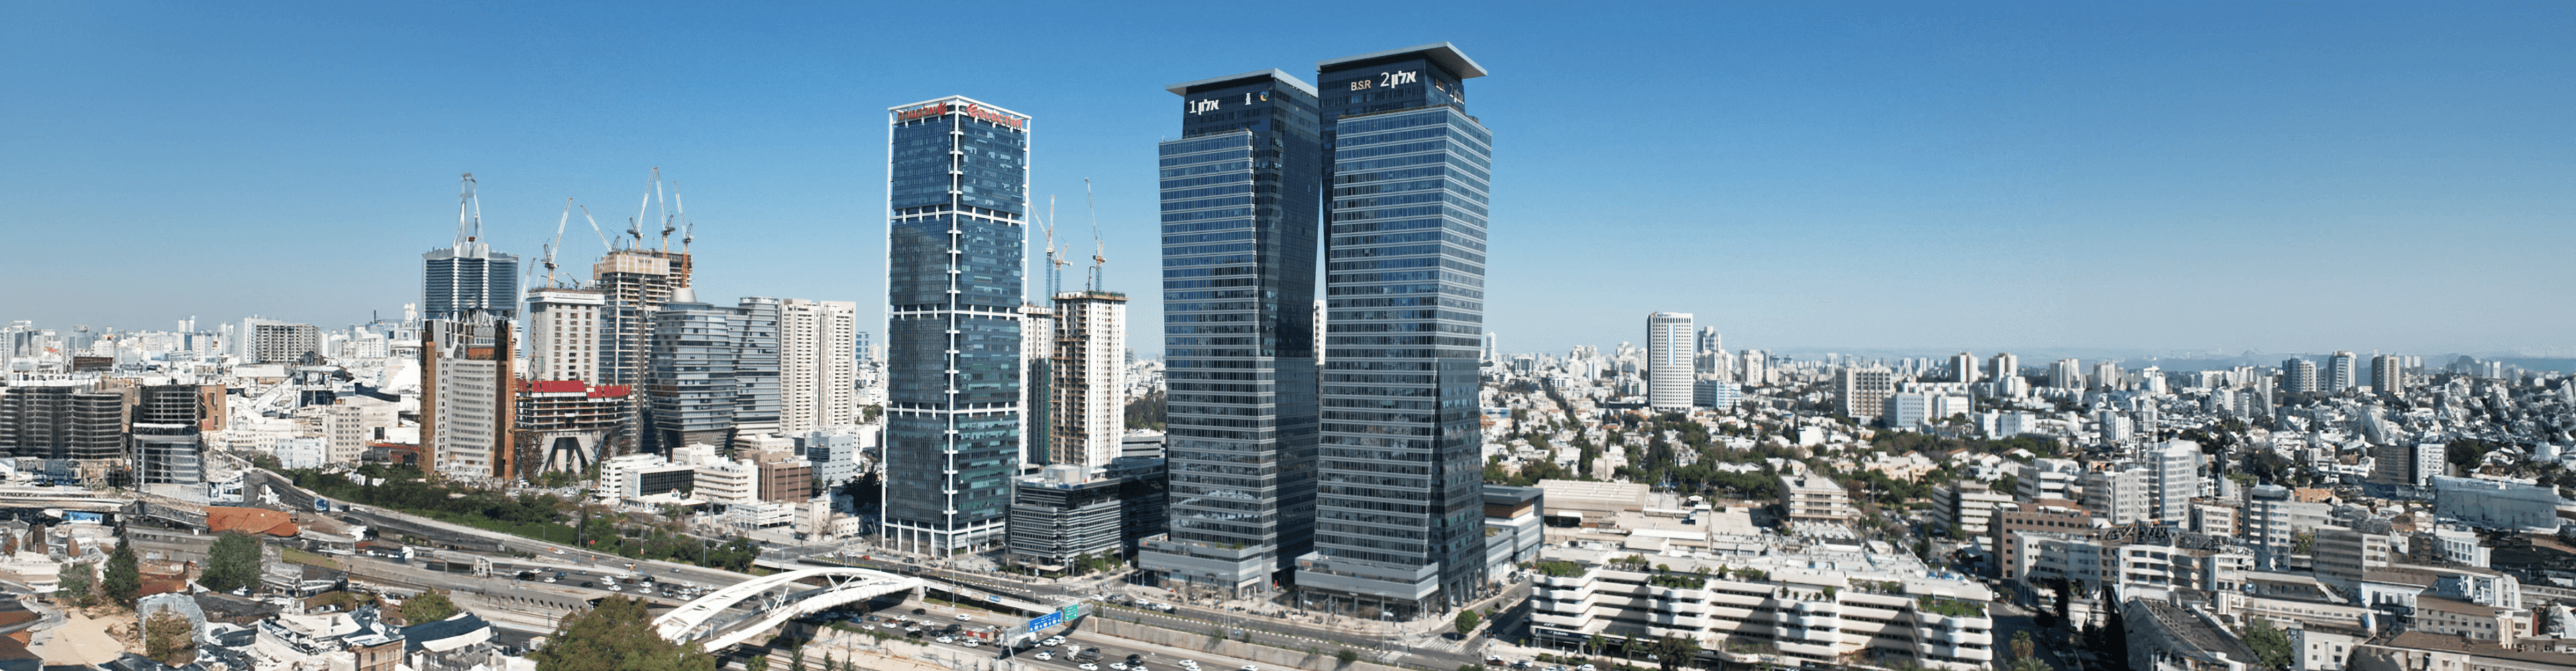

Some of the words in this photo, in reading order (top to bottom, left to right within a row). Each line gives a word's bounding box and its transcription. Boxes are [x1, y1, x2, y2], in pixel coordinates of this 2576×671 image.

[1380, 72, 1389, 87] 2
[1391, 67, 1417, 89] אלון
[898, 105, 936, 120] אלקטרה
[1189, 100, 1197, 113] 1
[1198, 99, 1220, 115] אלון
[979, 109, 1023, 127] ELECTRA
